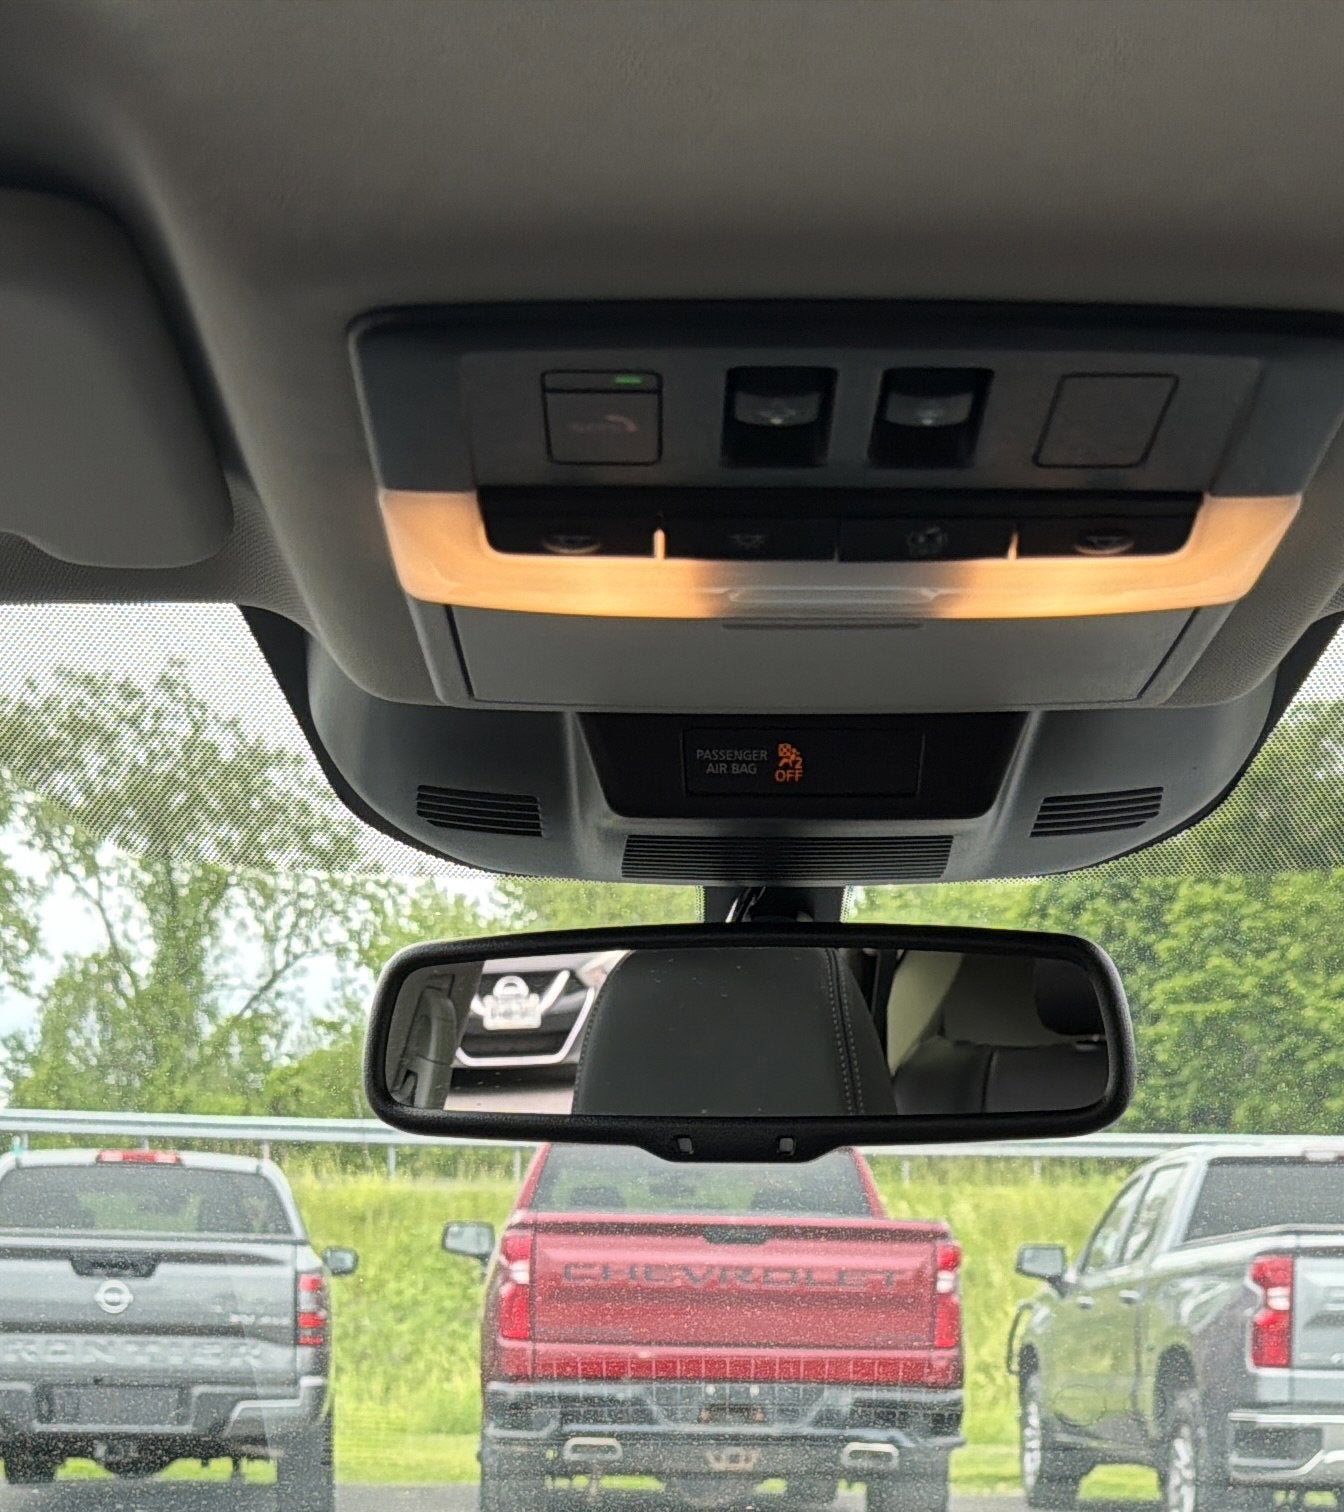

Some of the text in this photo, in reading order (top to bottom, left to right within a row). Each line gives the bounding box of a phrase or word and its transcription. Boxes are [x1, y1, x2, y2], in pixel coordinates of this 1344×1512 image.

[696, 749, 768, 761] PASSENGER
[706, 763, 757, 774] AIR BAG
[774, 769, 803, 782] OFF
[561, 1261, 900, 1291] CHEVROLET
